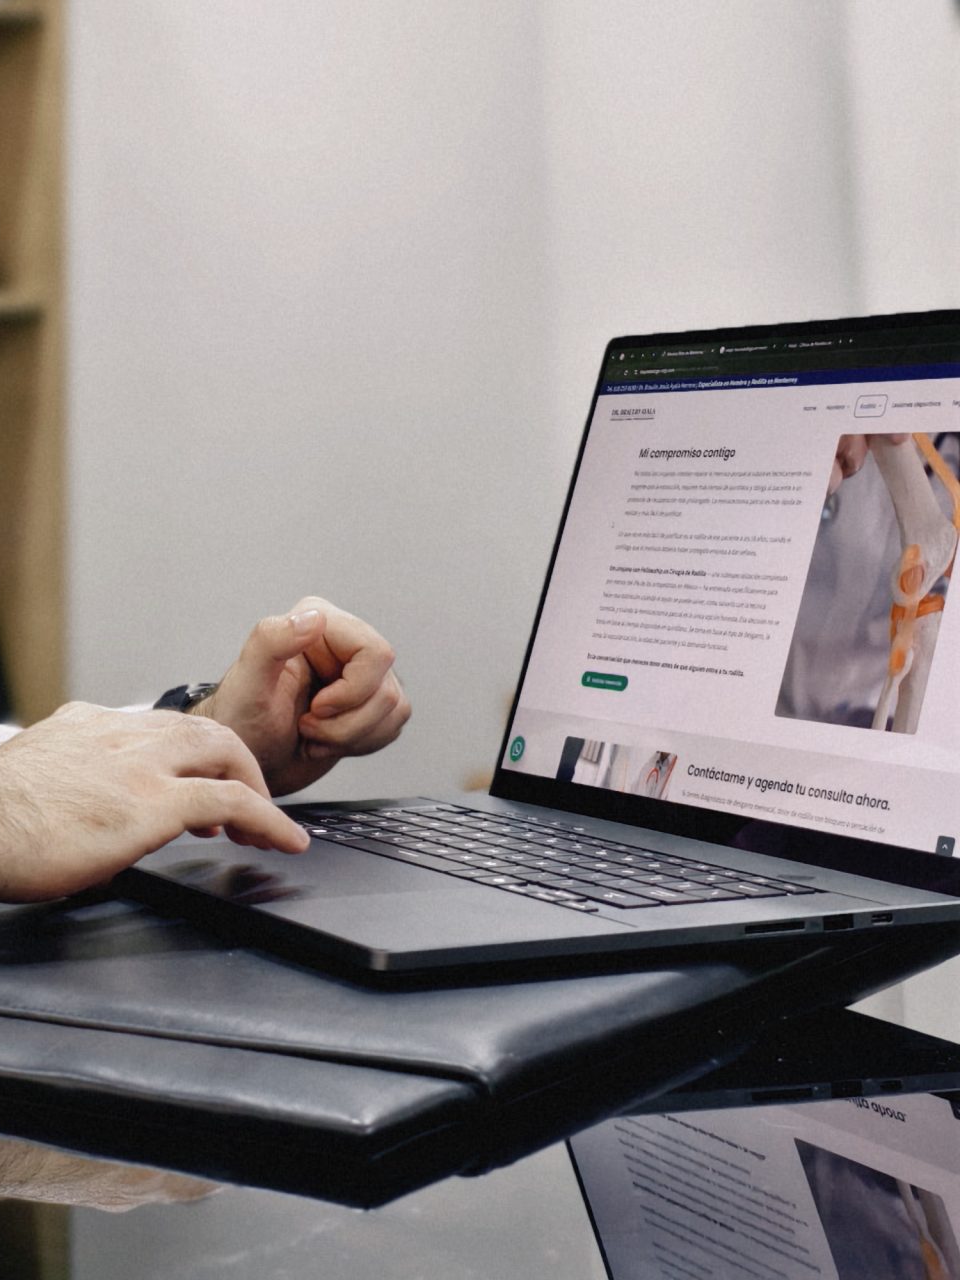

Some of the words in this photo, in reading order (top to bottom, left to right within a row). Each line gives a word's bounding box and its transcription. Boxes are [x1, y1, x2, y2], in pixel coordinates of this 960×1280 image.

[639, 448, 649, 458] Mi
[650, 447, 702, 461] compromiso
[703, 446, 736, 461] contigo
[687, 764, 745, 785] Contáctame
[746, 776, 753, 789] y
[755, 777, 793, 793] agenda
[795, 783, 805, 796] tu
[808, 785, 853, 804] consulta
[855, 794, 890, 811] ahora.
